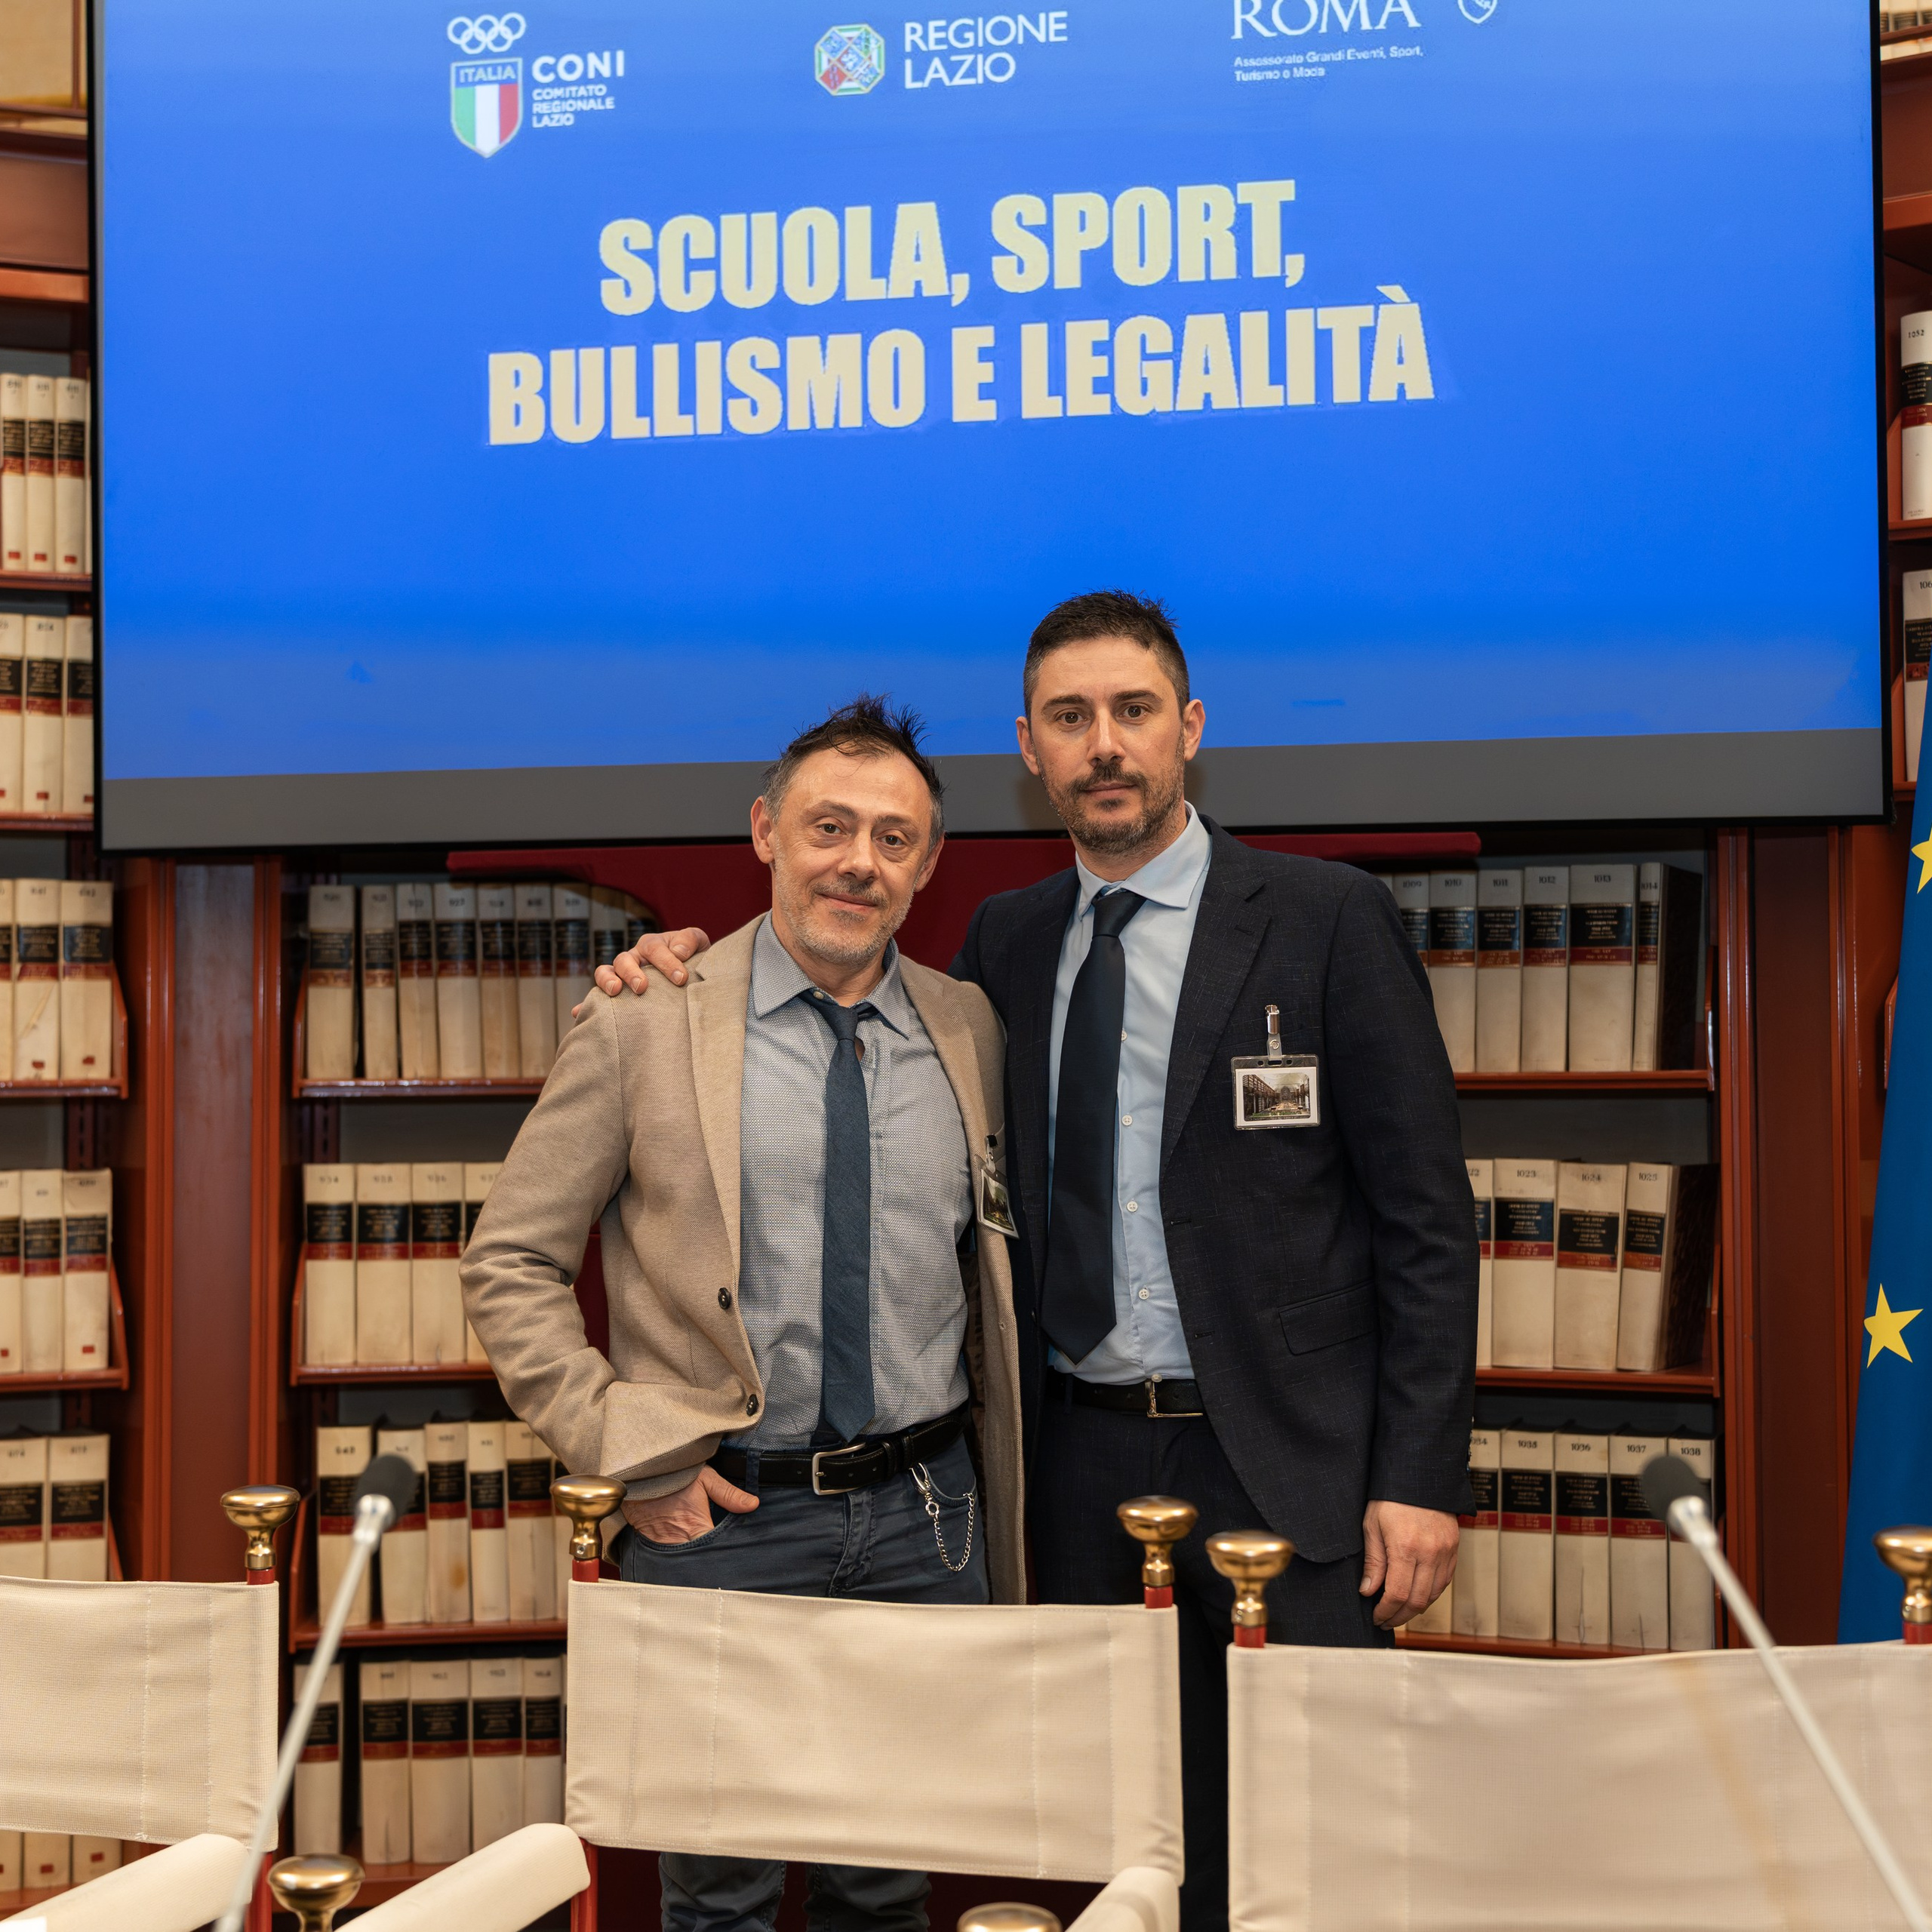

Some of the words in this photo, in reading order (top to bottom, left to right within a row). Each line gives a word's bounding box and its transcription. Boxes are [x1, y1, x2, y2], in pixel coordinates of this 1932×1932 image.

[1231, 0, 1422, 40] ROMA
[904, 10, 1069, 53] REGIONE
[1306, 50, 1344, 63] Grandi
[1346, 46, 1387, 60] Eventi,
[1389, 45, 1424, 58] Sport,
[459, 65, 516, 83] ITALIA
[531, 50, 626, 84] CONI
[904, 51, 1017, 89] LAZIO
[1234, 69, 1281, 82] Turismo
[531, 85, 608, 101] COMITATO
[531, 97, 616, 115] REGIONALE
[531, 113, 575, 129] LAZIO
[599, 202, 969, 316] SCUOLA,
[991, 179, 1306, 293] SPORT,
[1908, 329, 1925, 339] 1052
[488, 328, 927, 446] BULLISMO
[951, 325, 995, 423] E
[1020, 285, 1436, 420] LEGALITÀ
[1444, 878, 1463, 888] 1010
[1538, 875, 1557, 884] 1012
[1594, 874, 1612, 884] 1013
[1516, 1169, 1537, 1178] 1023
[1571, 1442, 1592, 1452] 1036
[1626, 1444, 1647, 1454] 1037
[1680, 1447, 1701, 1457] 1038
